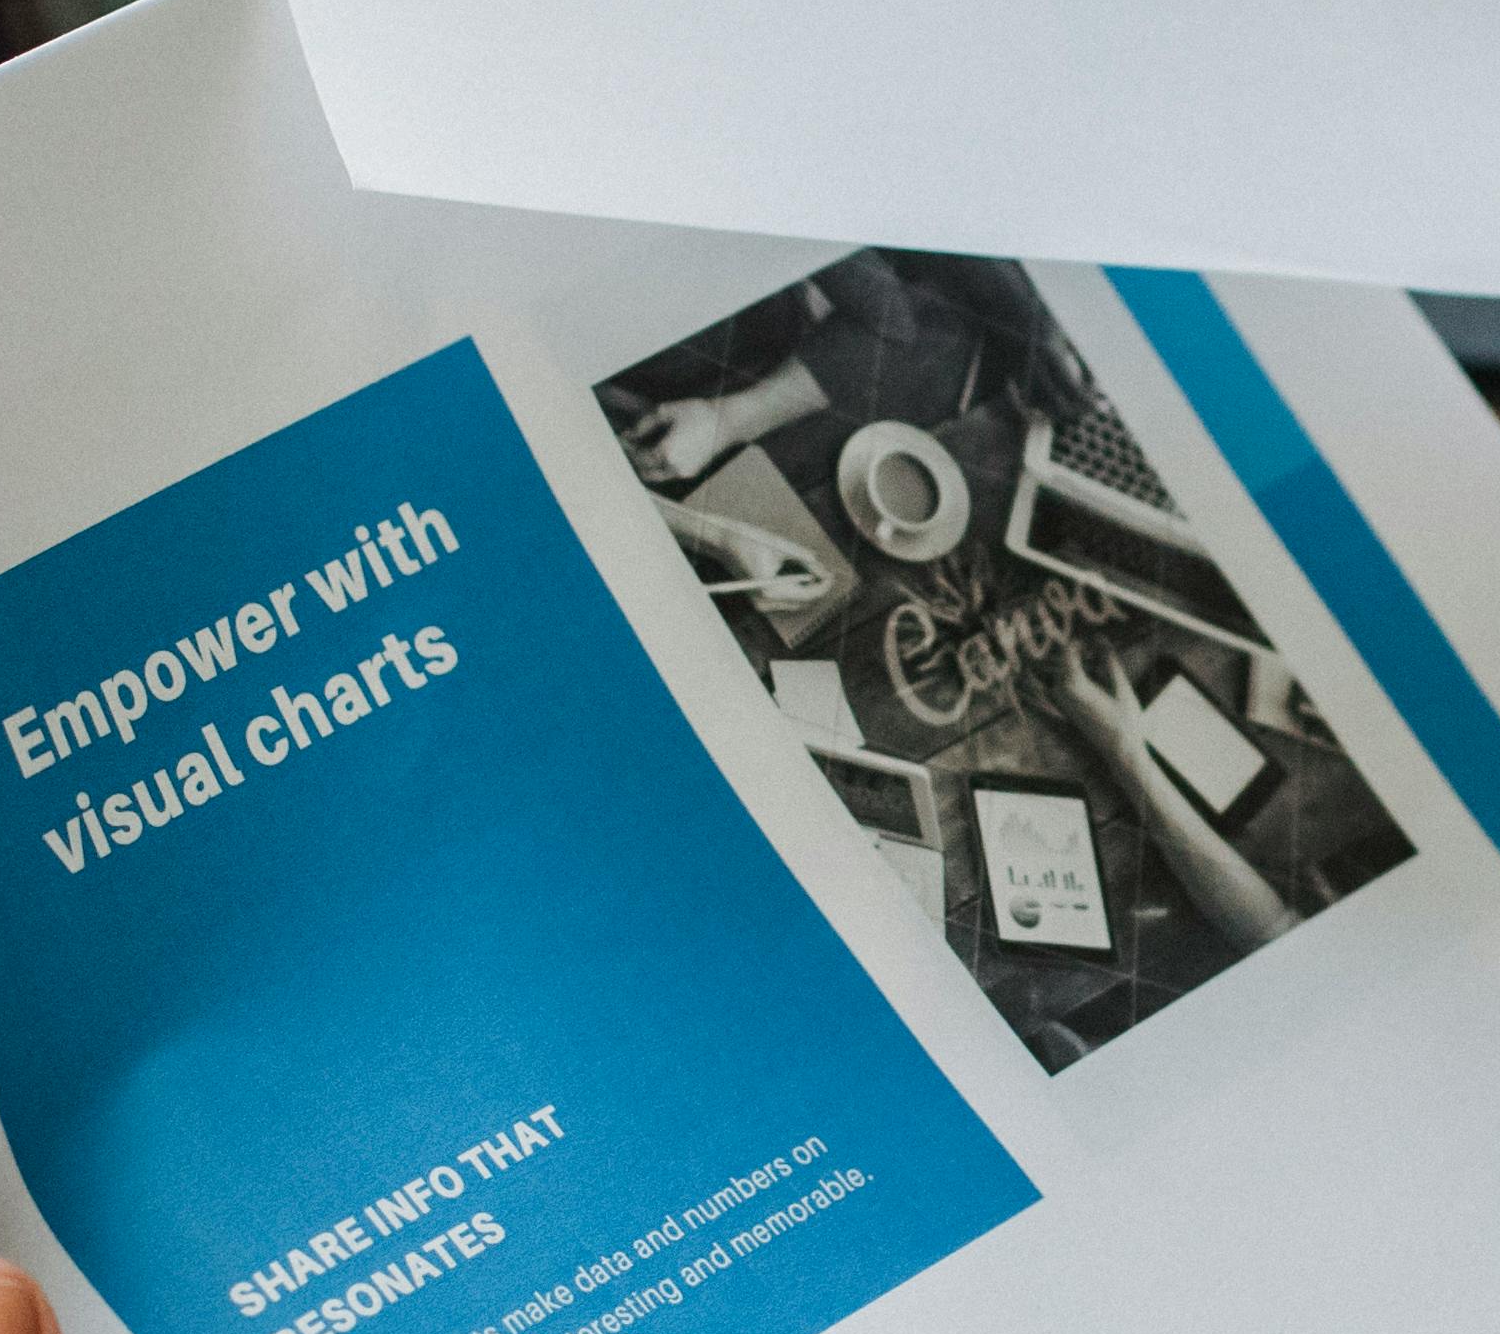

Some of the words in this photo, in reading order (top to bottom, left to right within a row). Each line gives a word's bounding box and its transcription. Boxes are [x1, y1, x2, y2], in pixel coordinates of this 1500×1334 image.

[2, 581, 301, 779] Empower
[304, 501, 461, 614] with
[884, 579, 1132, 727] Canva
[42, 723, 246, 874] visual
[245, 624, 459, 767] charts
[228, 1216, 375, 1318] SHARE
[363, 1164, 466, 1238] INFO
[458, 1104, 566, 1181] THAT
[573, 1249, 633, 1294] data
[633, 1216, 684, 1259] and
[681, 1153, 794, 1230] numbers
[791, 1133, 828, 1166] on
[680, 1243, 733, 1288] and
[729, 1162, 875, 1257] memorable.
